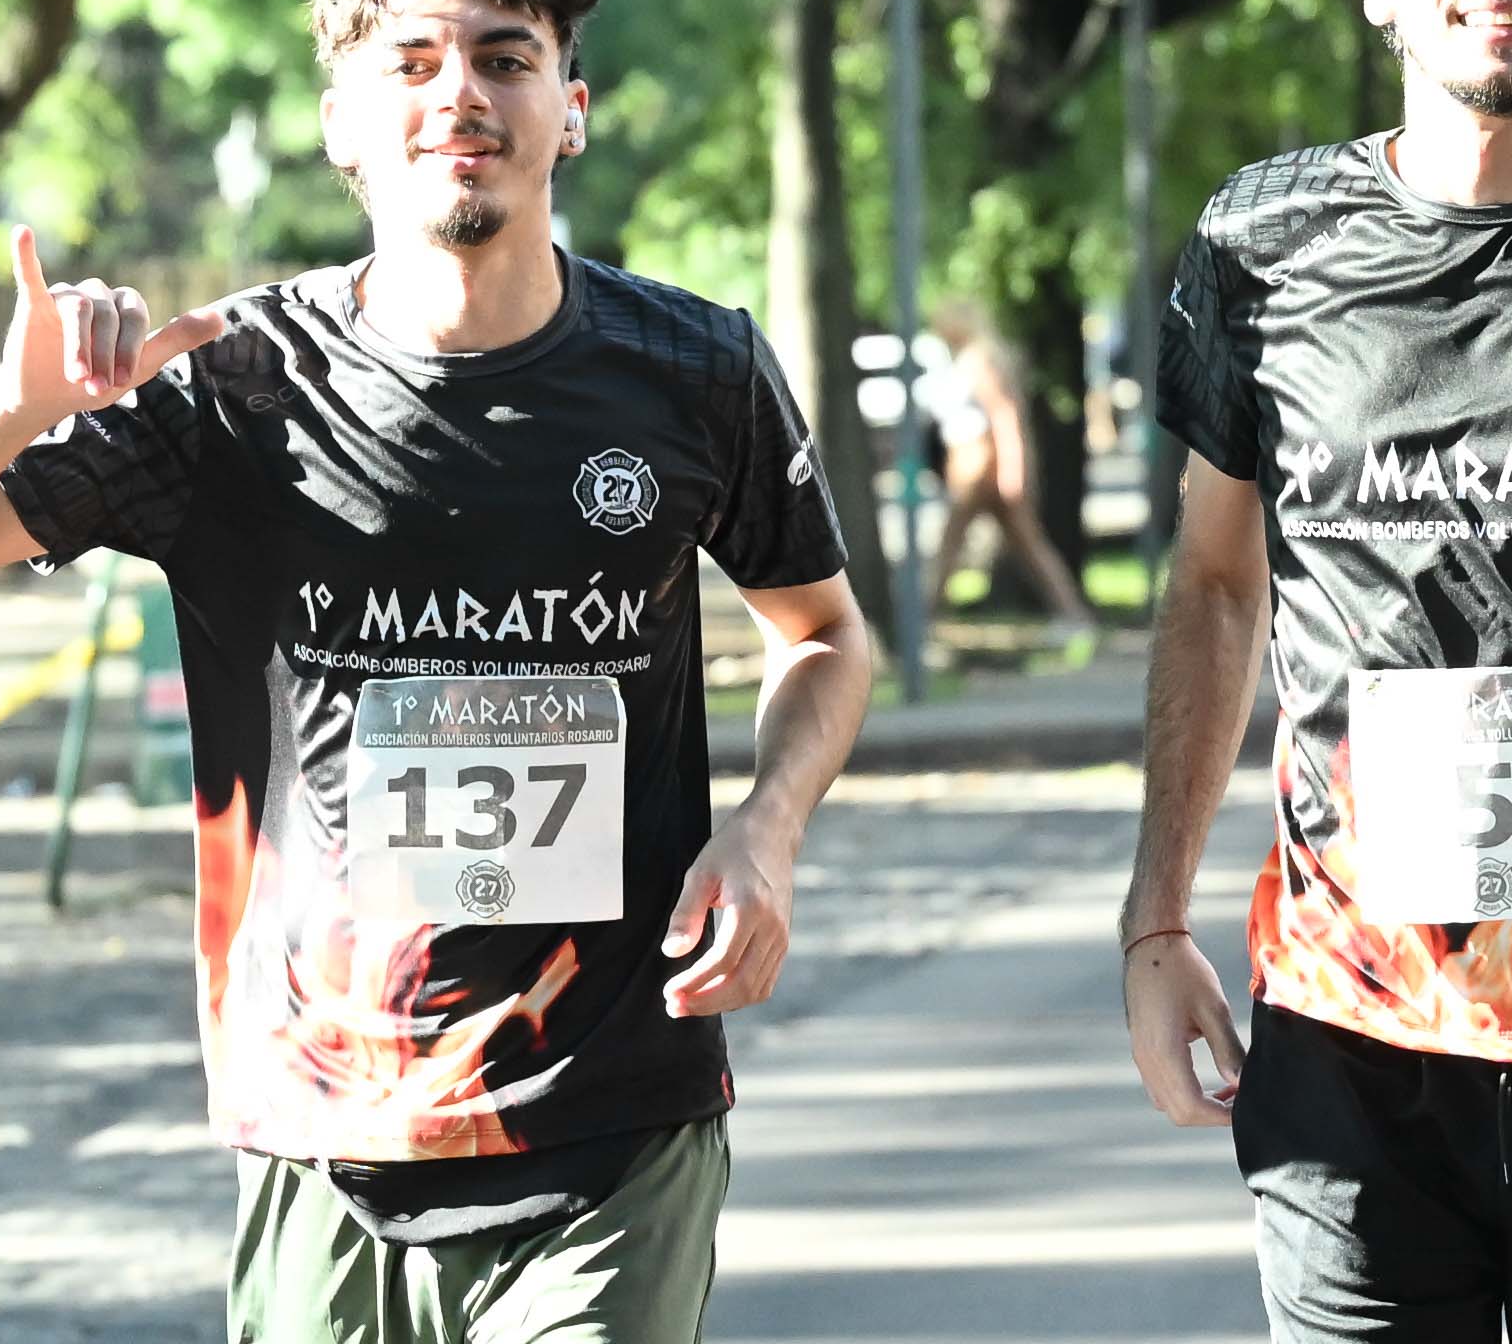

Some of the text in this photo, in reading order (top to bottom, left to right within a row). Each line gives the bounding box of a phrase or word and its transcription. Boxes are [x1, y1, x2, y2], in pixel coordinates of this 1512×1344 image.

[602, 475, 635, 503] 27
[1372, 519, 1470, 541] BOMBEROS
[359, 570, 647, 646] MARATÓN
[369, 656, 467, 676] BOMBEROS
[472, 659, 589, 678] VOLUNTARIOS
[429, 685, 586, 726] MARATÓN
[364, 729, 614, 747] ASOCIACIÓN BOMBEROS VOLUNTARIOS ROSARIO
[388, 763, 587, 851] 137
